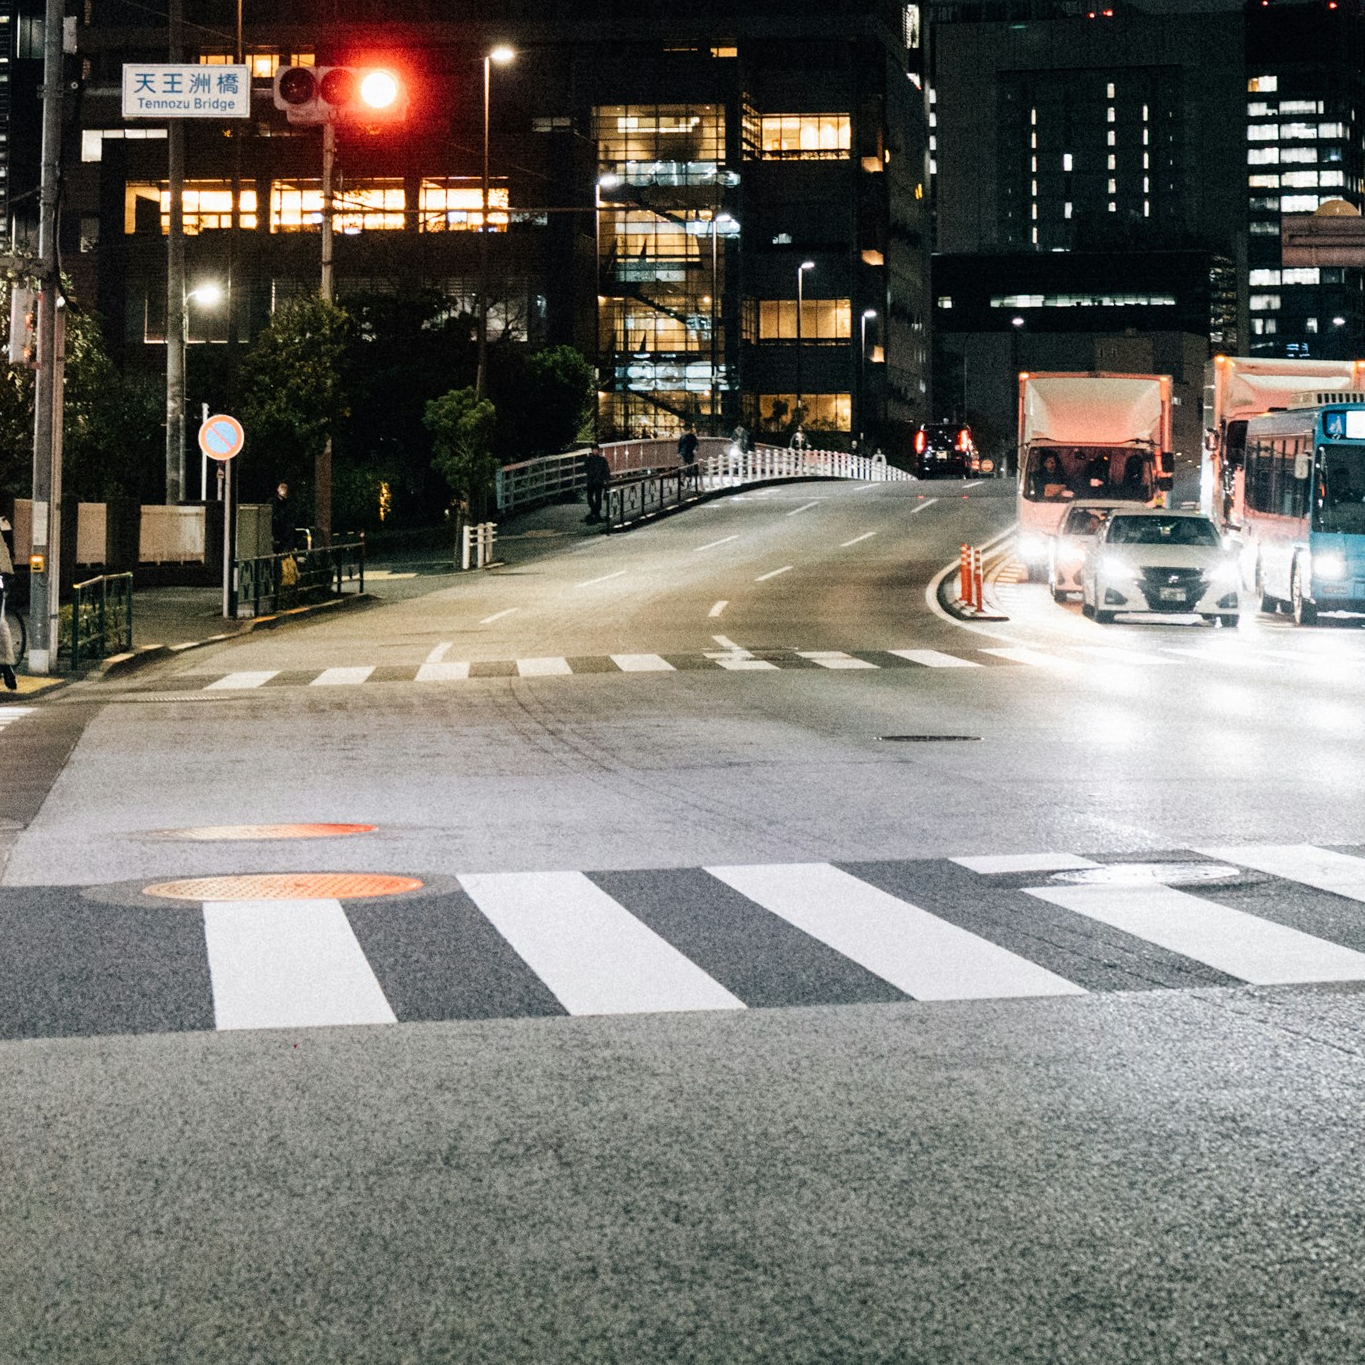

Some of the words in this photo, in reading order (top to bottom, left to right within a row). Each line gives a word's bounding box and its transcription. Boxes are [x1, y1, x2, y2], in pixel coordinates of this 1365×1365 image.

[133, 72, 240, 95] 天王洲橋
[137, 97, 190, 110] Tennozu
[194, 97, 236, 112] Bridge
